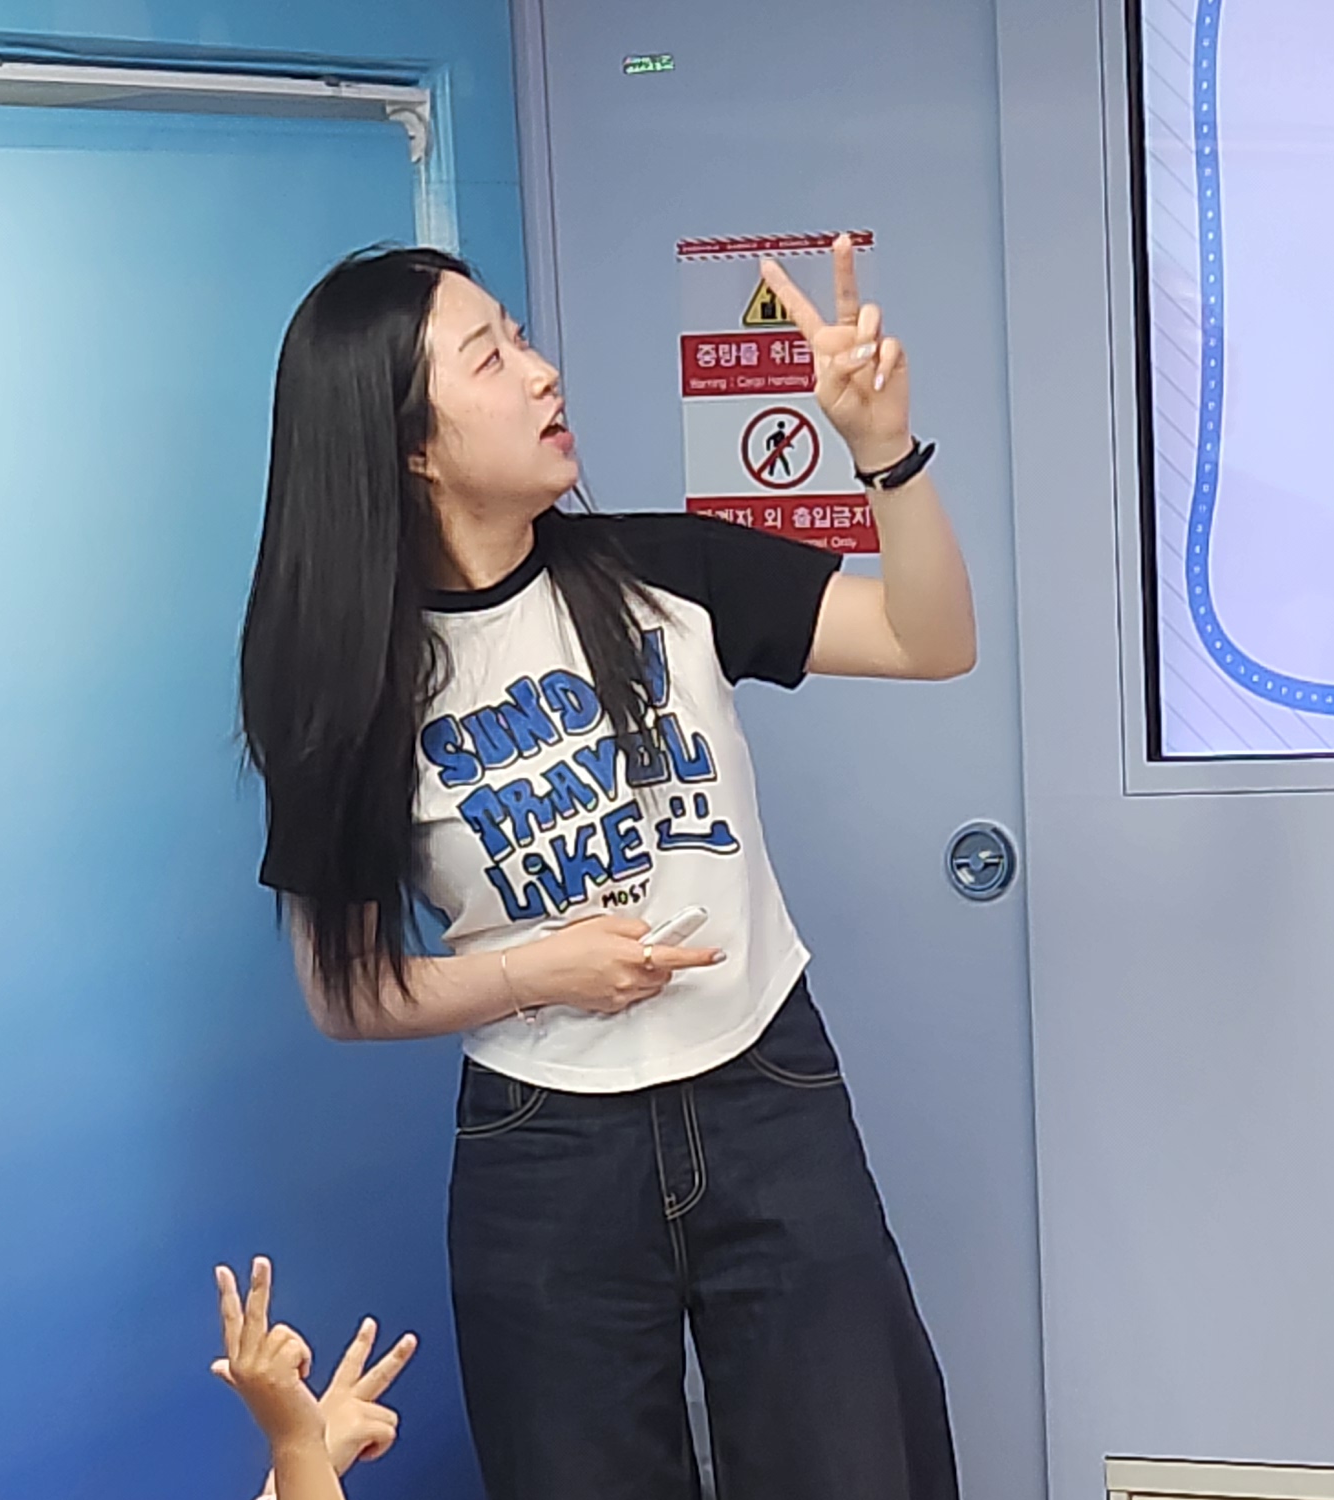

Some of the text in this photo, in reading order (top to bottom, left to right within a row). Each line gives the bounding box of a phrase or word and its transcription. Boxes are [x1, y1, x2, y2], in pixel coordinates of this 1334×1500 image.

[737, 375, 765, 388] Cargo
[764, 507, 783, 529] 외
[792, 505, 871, 529] 출입금지
[831, 536, 857, 549] Only
[601, 878, 652, 908] MOST
